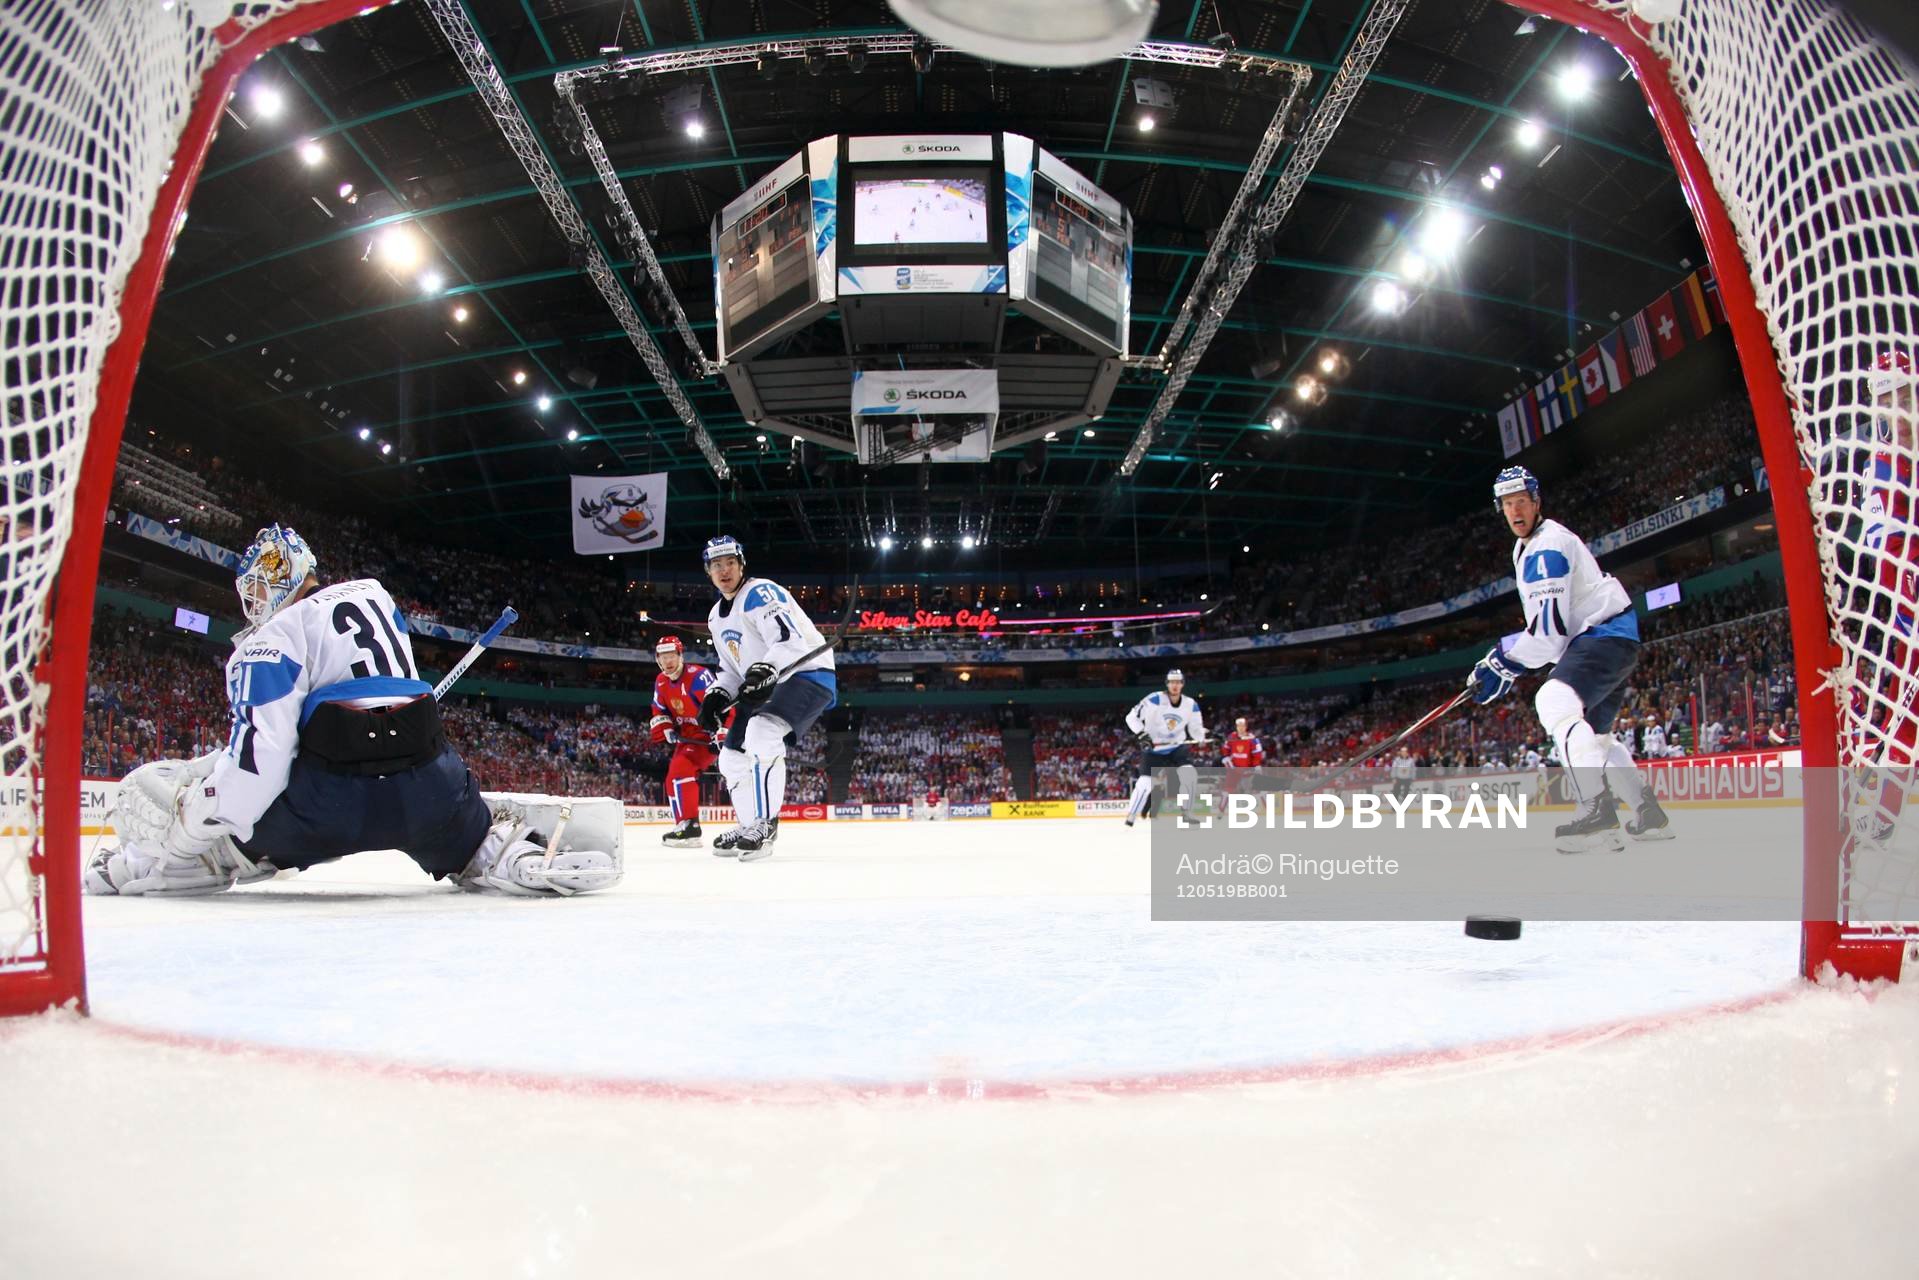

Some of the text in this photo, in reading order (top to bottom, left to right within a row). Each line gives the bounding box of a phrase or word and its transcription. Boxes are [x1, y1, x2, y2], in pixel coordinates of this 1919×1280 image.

[918, 144, 961, 153] ŠKODA
[758, 178, 777, 198] IIHF
[906, 388, 967, 400] ŠKODA
[1625, 505, 1685, 542] HELSINKI
[1536, 554, 1548, 579] 4
[859, 609, 997, 631] Silver Star Cafe
[332, 598, 412, 679] 31
[700, 670, 714, 686] 27
[681, 683, 687, 695] A
[873, 806, 899, 814] NIVEA
